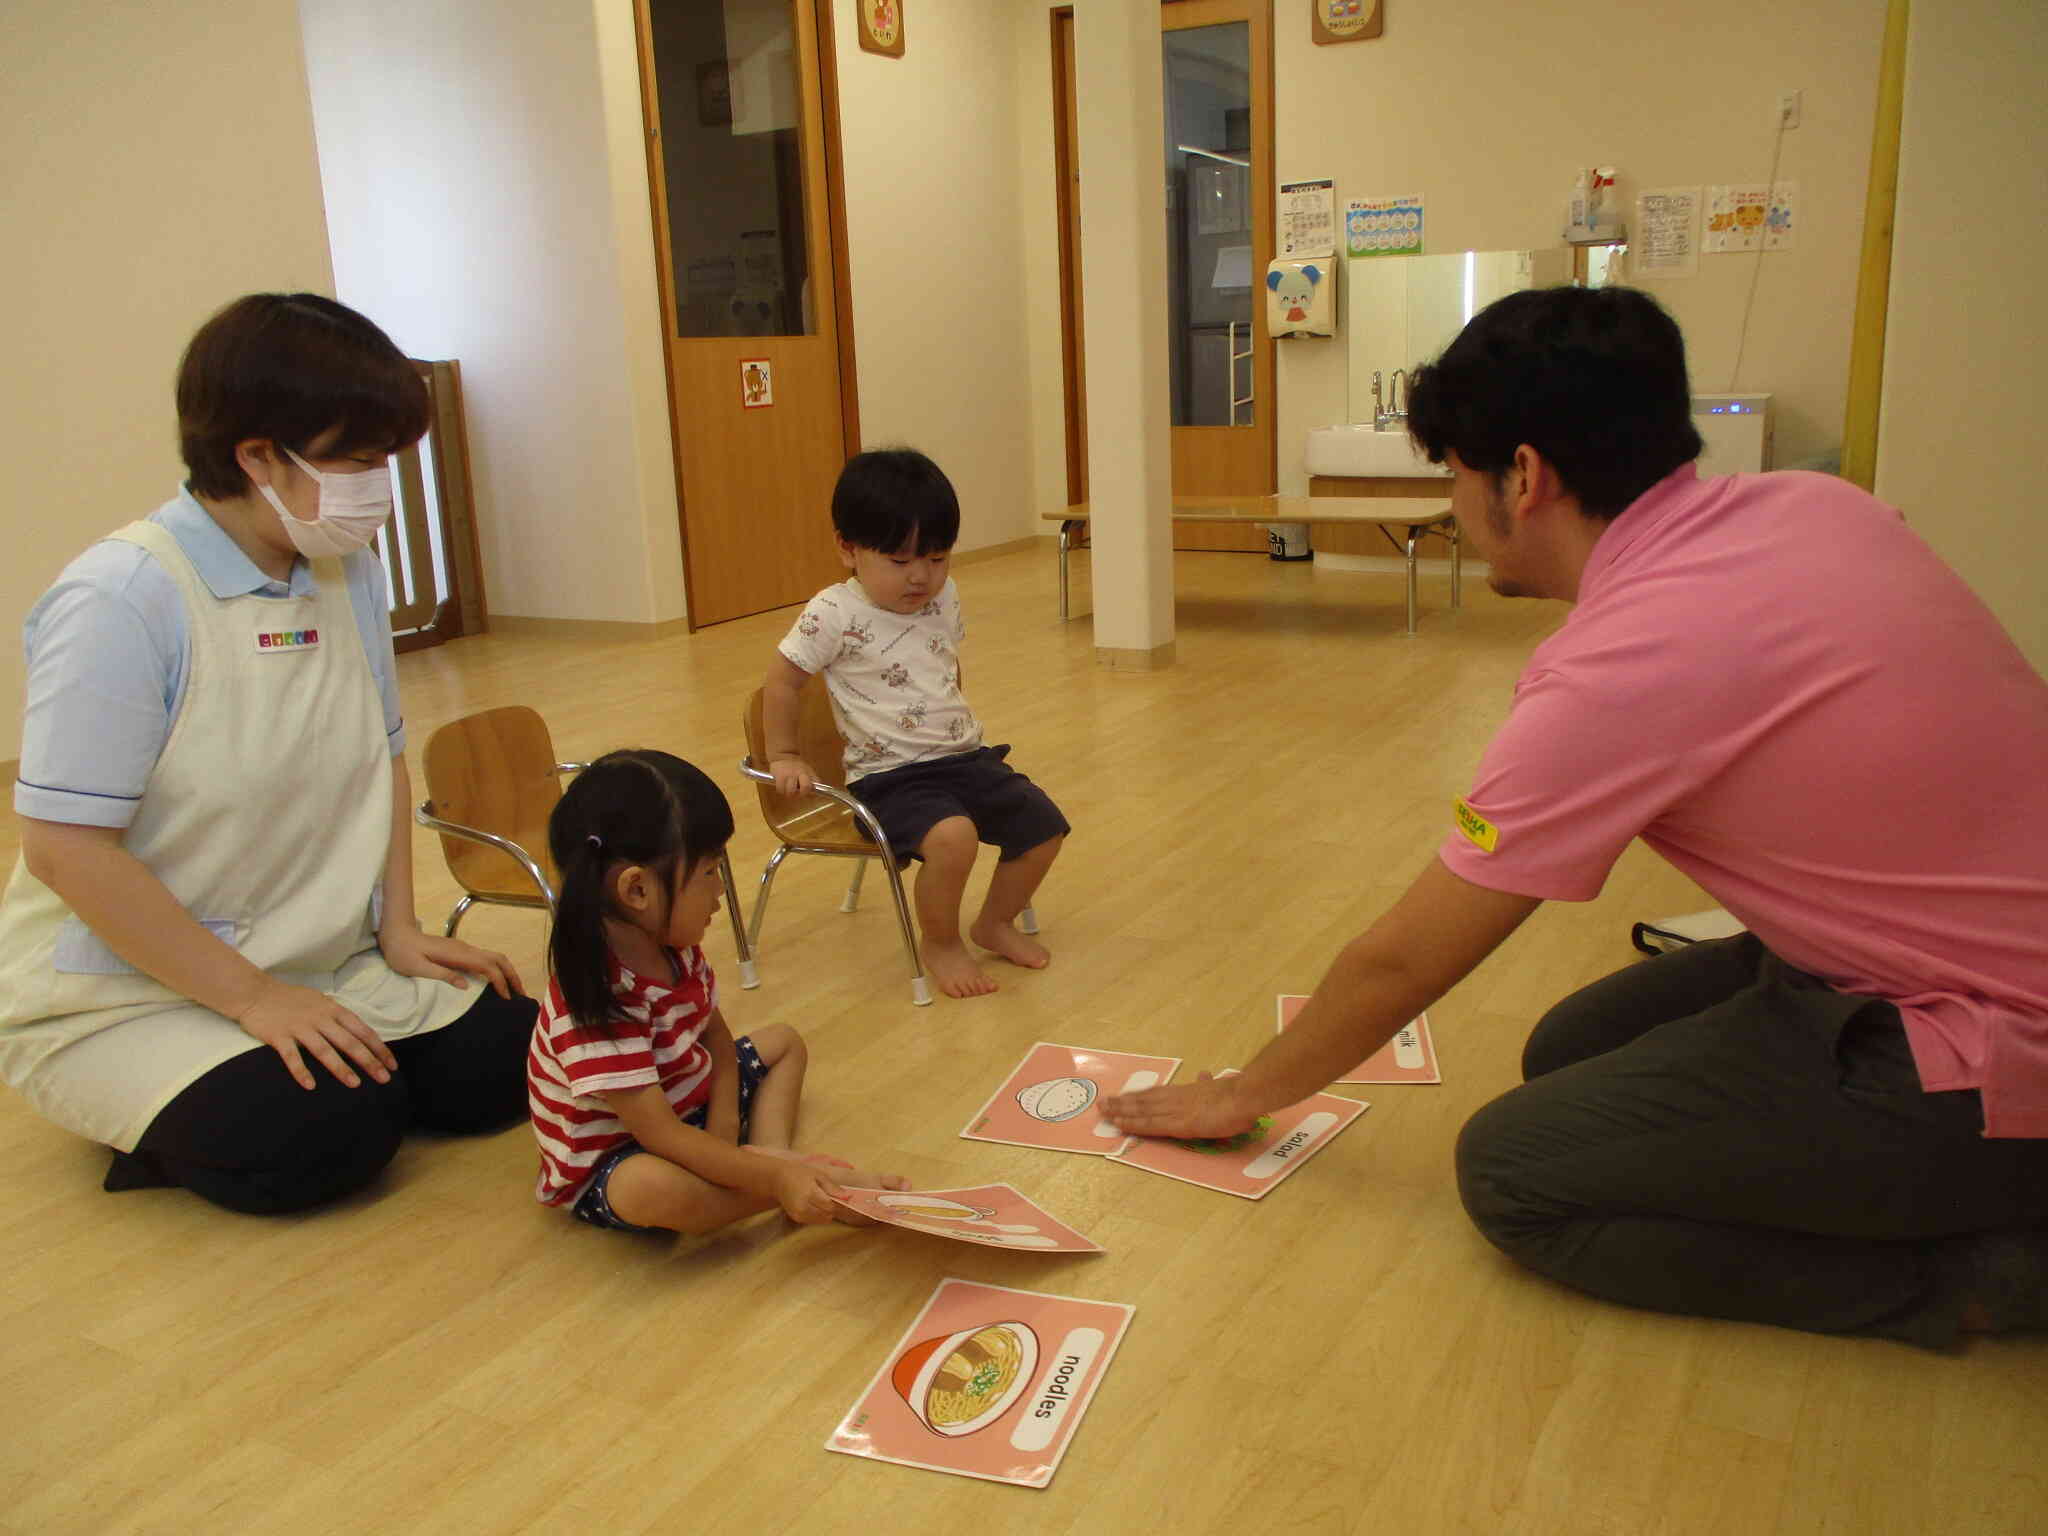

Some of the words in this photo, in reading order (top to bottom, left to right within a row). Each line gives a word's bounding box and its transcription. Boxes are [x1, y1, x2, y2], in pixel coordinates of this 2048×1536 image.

[1399, 1031, 1417, 1048] milk
[1272, 1131, 1310, 1159] salad
[1034, 1354, 1081, 1419] noodles
